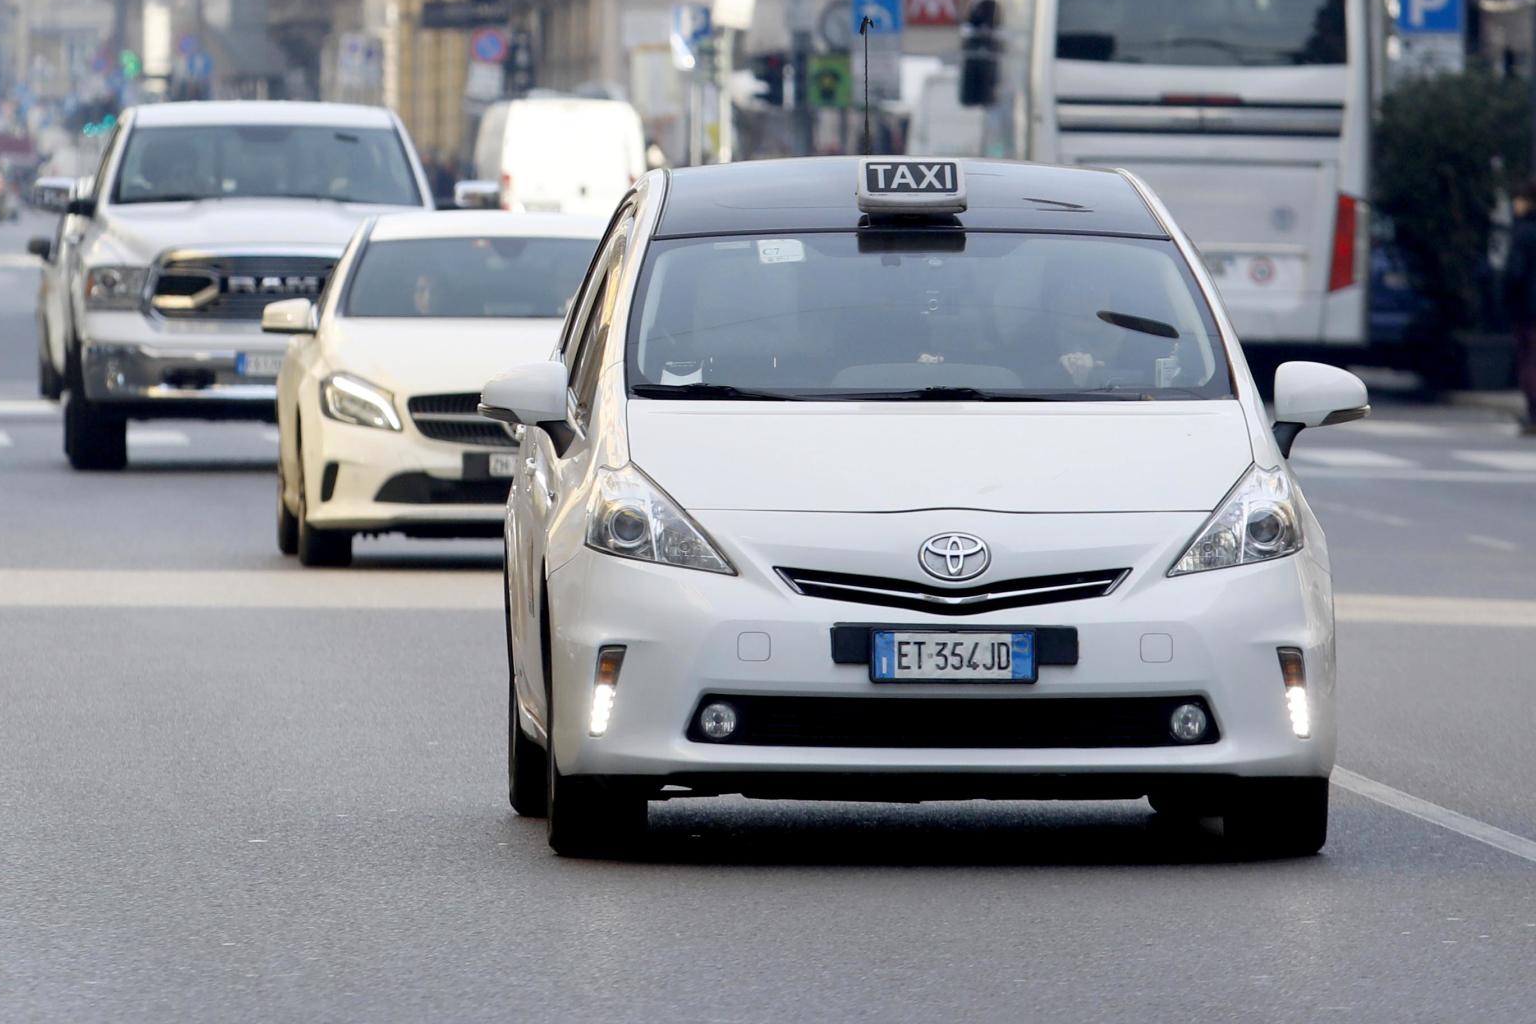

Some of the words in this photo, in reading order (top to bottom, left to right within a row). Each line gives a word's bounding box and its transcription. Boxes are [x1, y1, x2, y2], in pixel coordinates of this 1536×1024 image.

[869, 164, 953, 189] TAXI
[227, 275, 320, 294] RAM
[897, 641, 926, 670] ET
[935, 642, 1010, 671] 354JD
